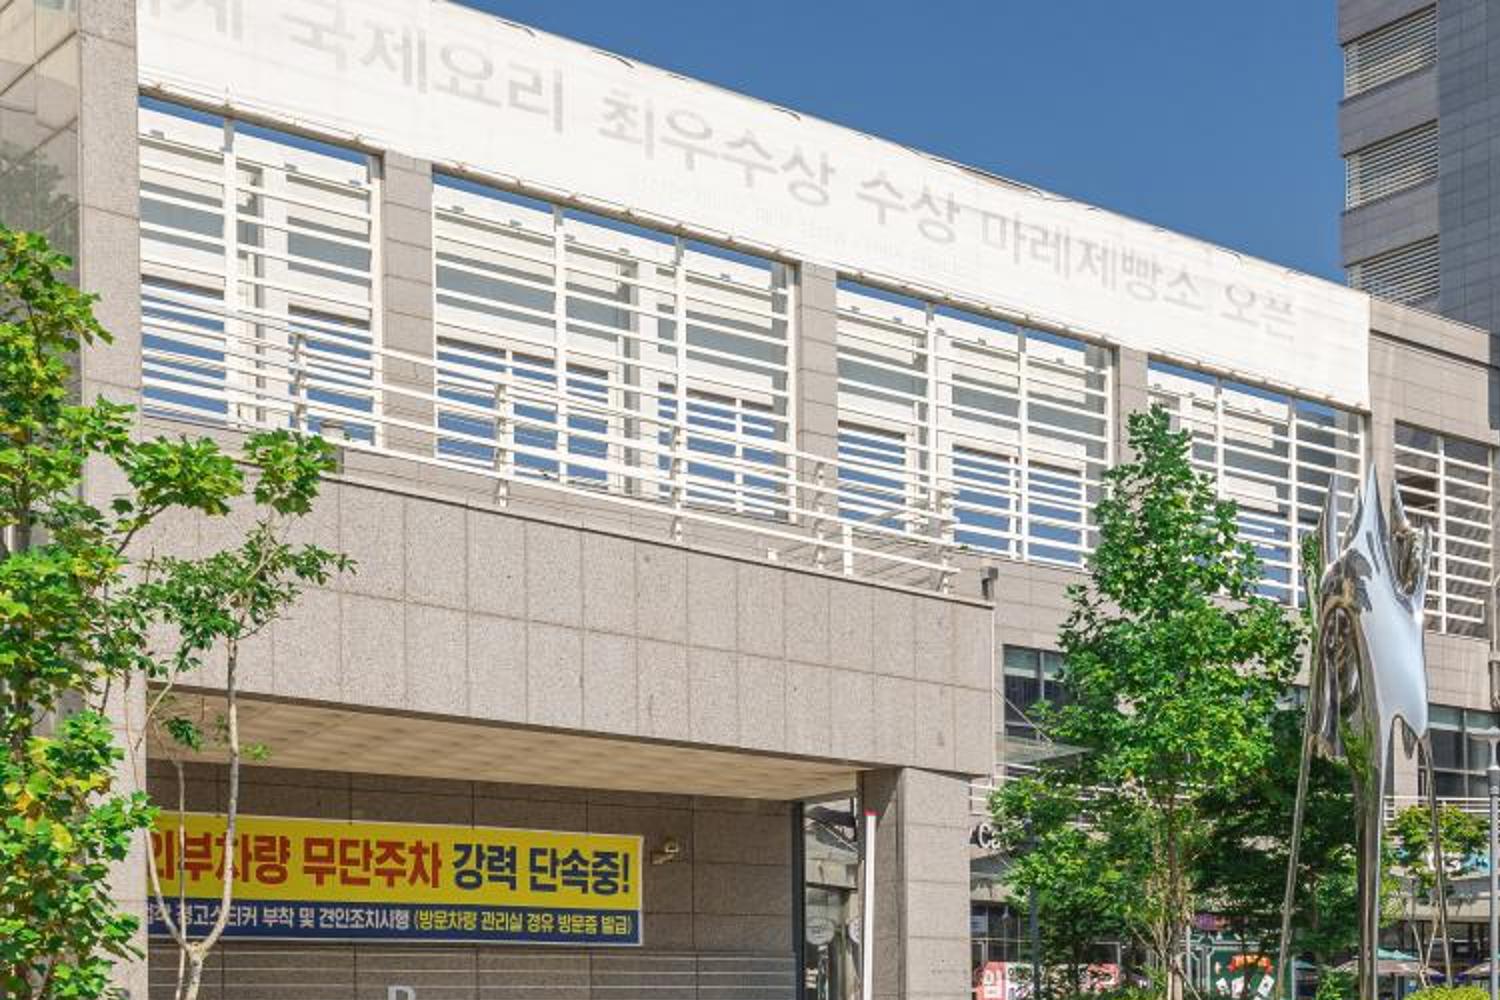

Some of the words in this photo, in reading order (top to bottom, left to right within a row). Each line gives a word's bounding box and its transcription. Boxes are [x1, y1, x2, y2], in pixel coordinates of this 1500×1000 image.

[279, 2, 565, 133] 국제요리
[597, 87, 835, 206] 최우수상
[855, 169, 961, 243] 수상
[979, 210, 1204, 311] 마레제빵소
[1219, 282, 1296, 344] 오픈
[303, 836, 442, 888] 무단주차
[452, 843, 517, 891] 강력
[529, 847, 630, 895] 단속중!
[262, 907, 294, 928] 부착
[299, 907, 316, 929] 및
[319, 908, 410, 931] 견인조치시행
[415, 909, 477, 931] (방문차량
[481, 911, 523, 932] 관리실
[527, 912, 554, 933] 경유
